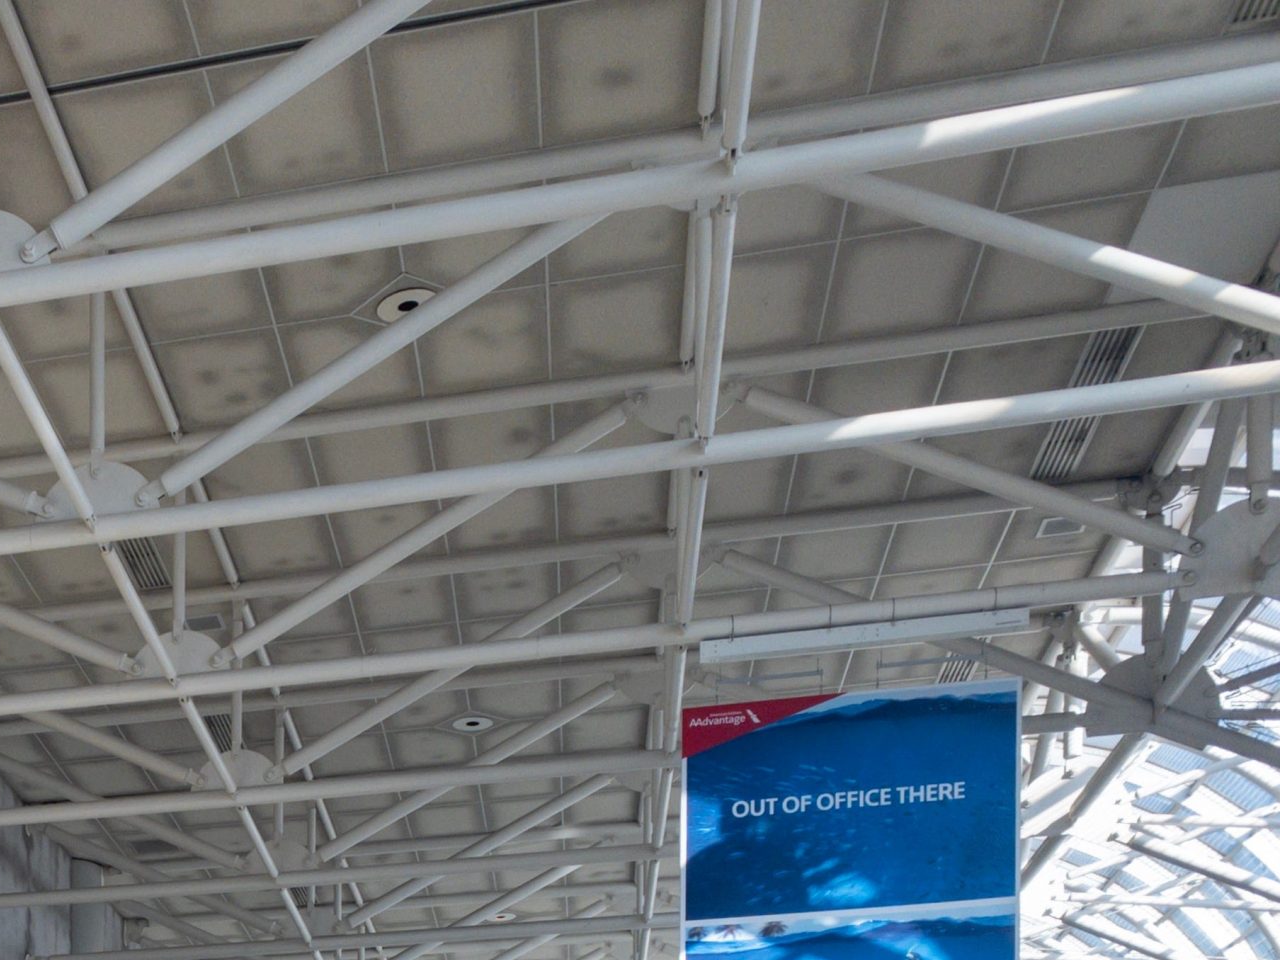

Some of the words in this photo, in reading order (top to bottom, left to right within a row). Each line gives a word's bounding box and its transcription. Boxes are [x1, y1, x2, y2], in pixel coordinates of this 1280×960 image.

[689, 715, 746, 728] AAdvantage
[731, 798, 778, 818] OUT
[782, 794, 812, 814] OF
[816, 787, 892, 811] OFFICE
[896, 781, 966, 804] THERE
